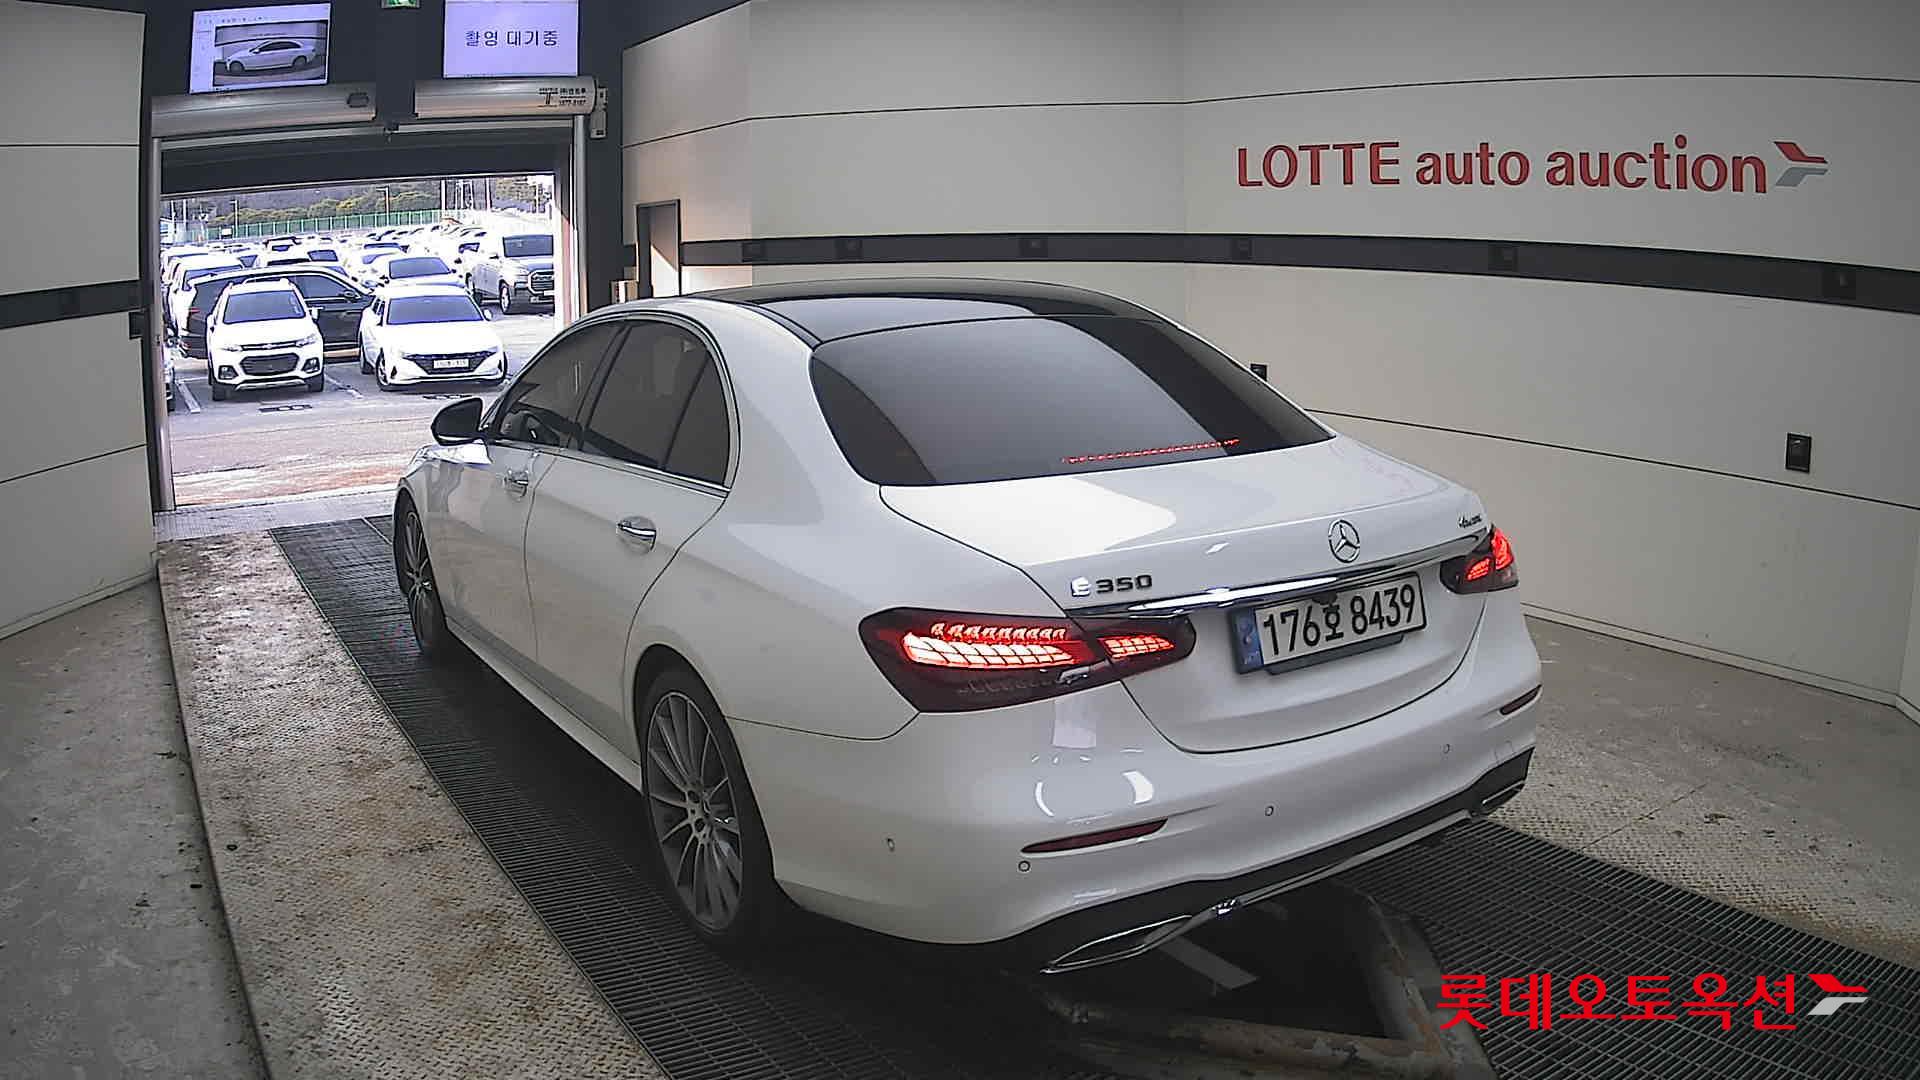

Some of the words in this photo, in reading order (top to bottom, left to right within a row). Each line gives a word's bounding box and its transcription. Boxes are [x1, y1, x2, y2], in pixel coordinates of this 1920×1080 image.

[506, 31, 557, 47] 대기중
[1239, 141, 1399, 187] LOTTE
[1415, 142, 1530, 186] auto
[1546, 135, 1767, 193] auction
[1095, 574, 1152, 594] 350
[1264, 602, 1344, 655] 176호
[1350, 584, 1415, 635] 8439
